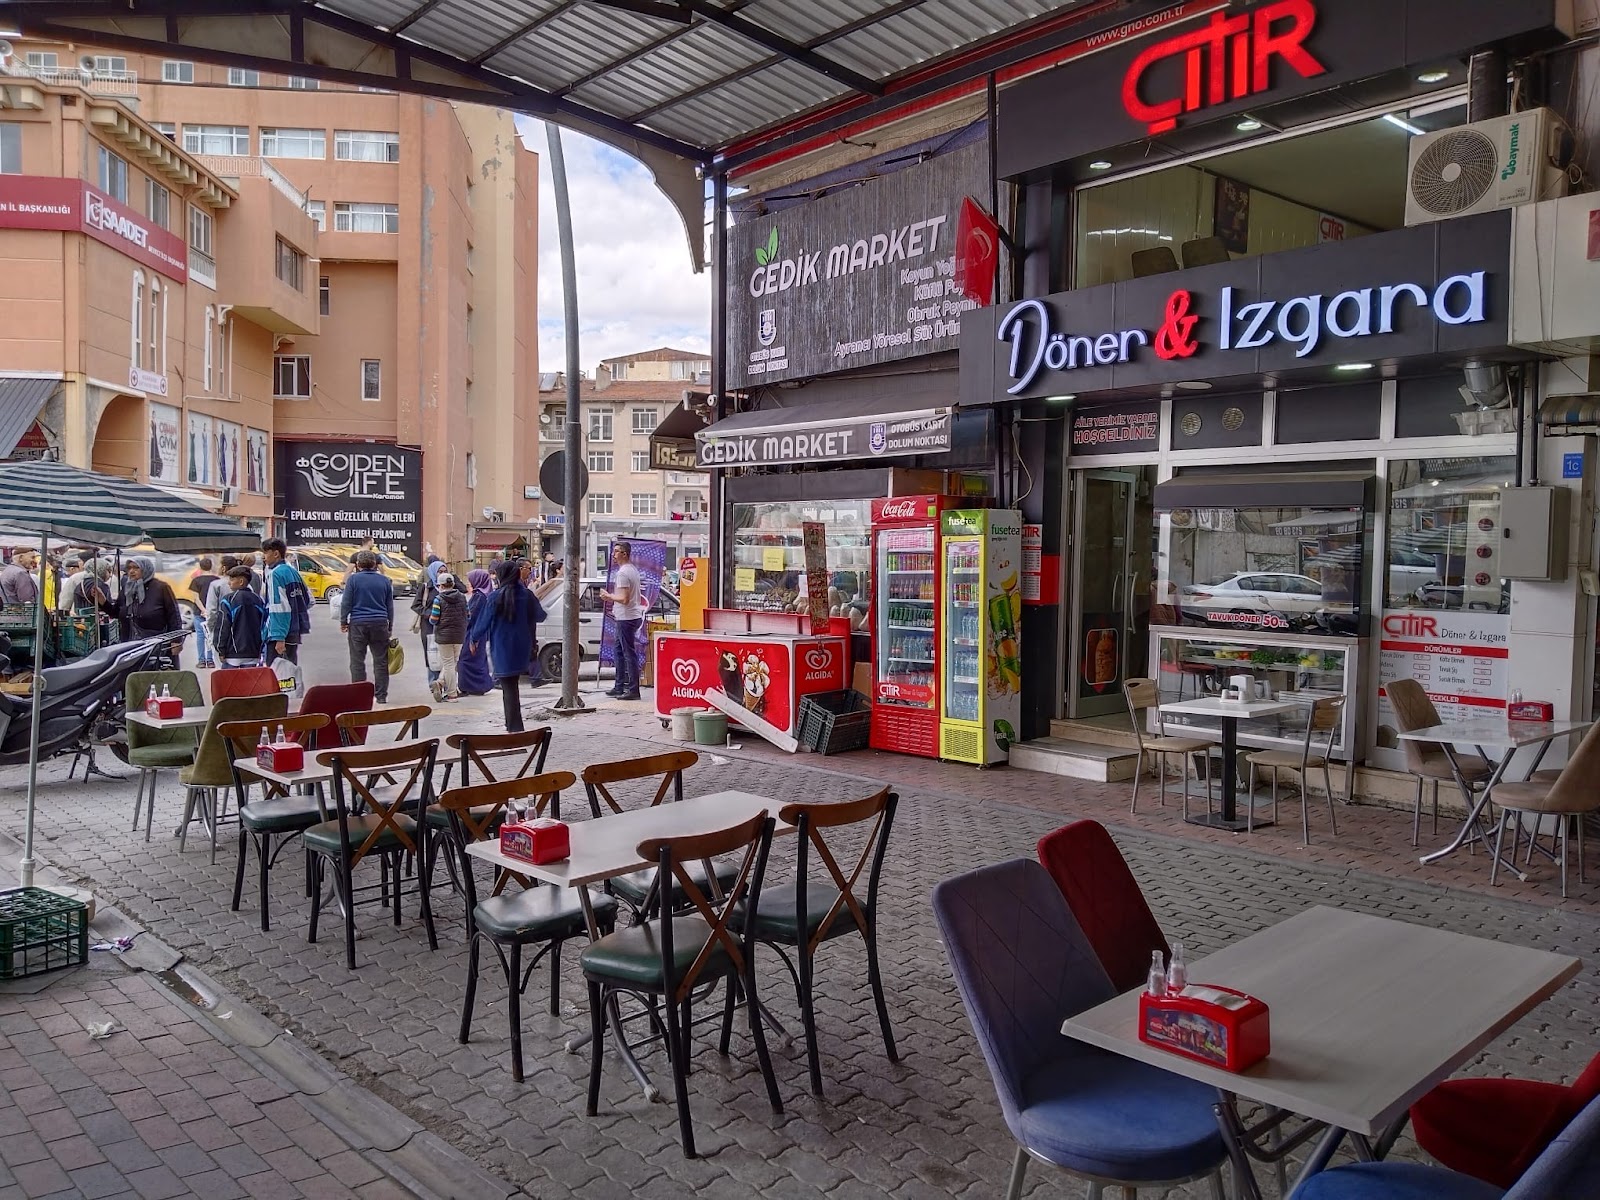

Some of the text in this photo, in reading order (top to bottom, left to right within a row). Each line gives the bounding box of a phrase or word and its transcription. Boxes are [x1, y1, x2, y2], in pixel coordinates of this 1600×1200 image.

[1086, 5, 1185, 48] www.gno.com.tr
[9, 202, 17, 212] İL
[19, 204, 71, 214] BAŞKANLIĞI
[103, 207, 148, 248] SAADET
[750, 215, 947, 298] GEDİK MARKET
[901, 256, 966, 285] Koyun Yoğu
[945, 279, 965, 296] Pey
[907, 303, 941, 322] Obruk
[873, 328, 912, 349] Yöresel
[913, 325, 933, 342] Süt
[997, 270, 1486, 394] Döner & Izgara
[891, 420, 946, 433] OTOBÜS KARTI
[1073, 423, 1156, 445] HOŞGELDİNİZ
[701, 430, 853, 464] GEDİK MARKET
[888, 435, 948, 449] DOLUM NOKTASI
[310, 453, 404, 473] GOLDEN
[350, 471, 404, 497] LIFE
[290, 509, 415, 522] EPİLASYON GÜZELLİK HİZMETLERİ
[301, 527, 322, 538] SOĞUK
[372, 528, 406, 539] EPİLASYON
[992, 523, 1020, 536] fusetea
[1207, 612, 1233, 622] TAVUK
[1234, 612, 1261, 624] DÖNER
[1469, 630, 1478, 640] &
